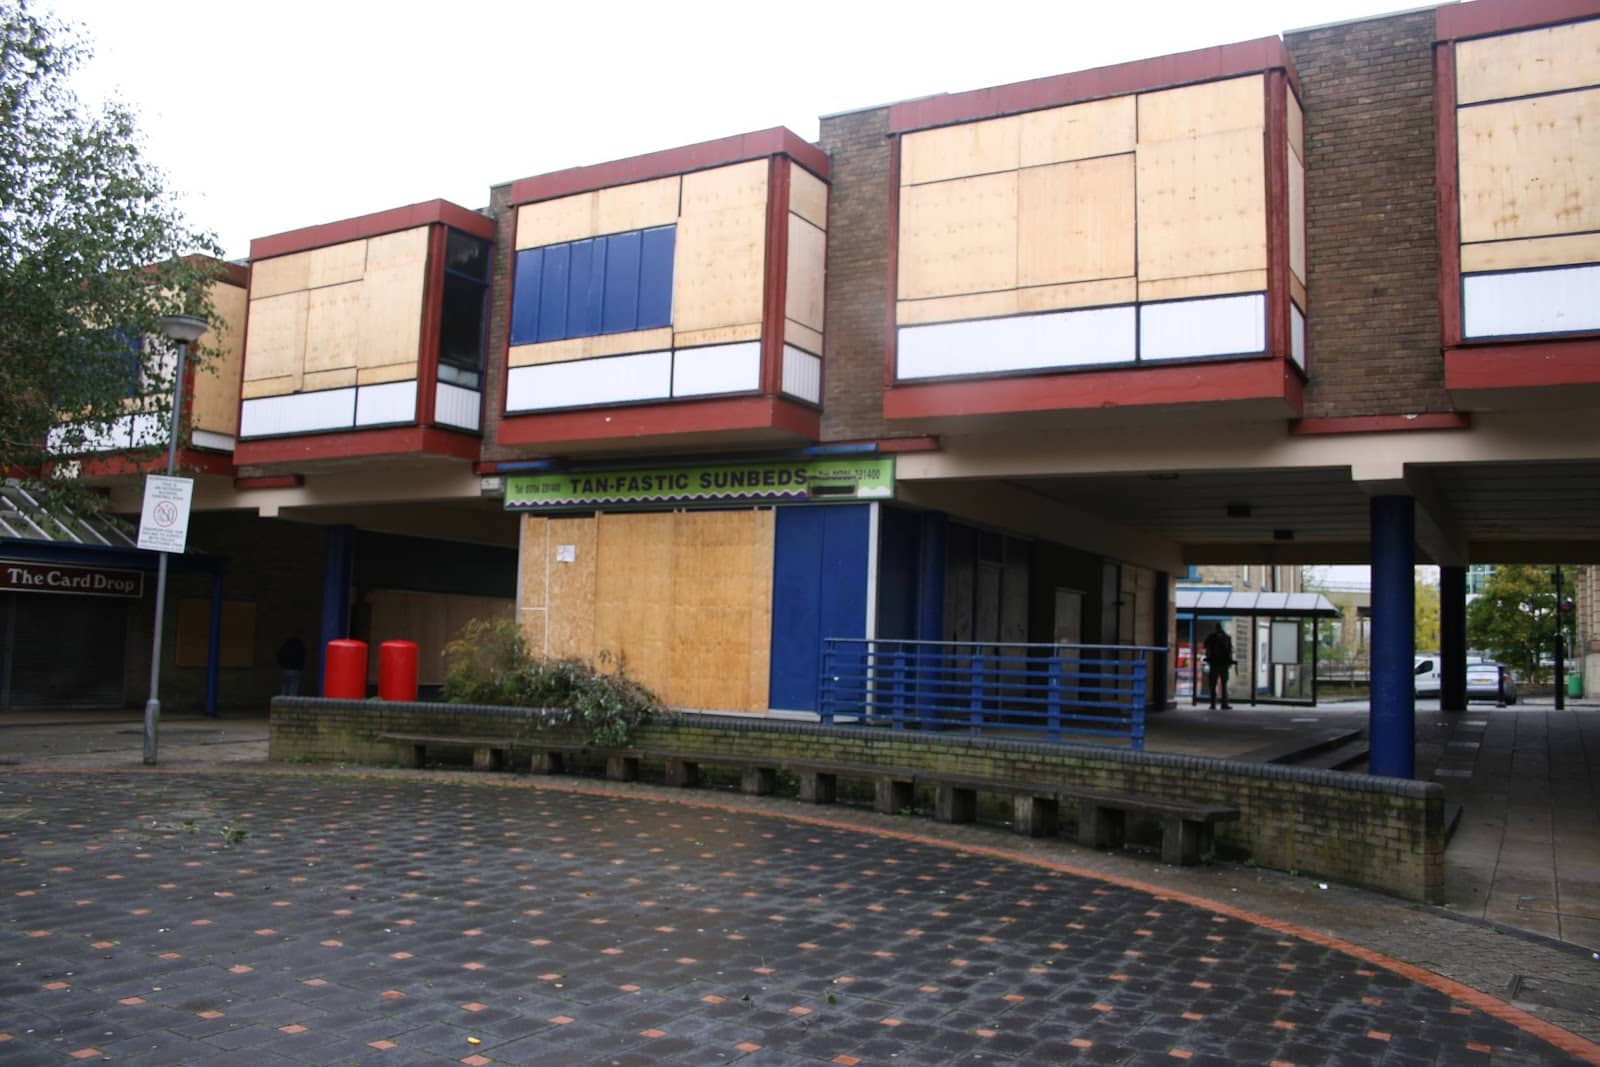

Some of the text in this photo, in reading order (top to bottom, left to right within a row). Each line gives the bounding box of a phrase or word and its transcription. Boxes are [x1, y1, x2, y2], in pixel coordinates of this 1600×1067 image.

[570, 473, 689, 494] TAN-FASTIC
[699, 468, 808, 489] SUNBEDS
[7, 567, 135, 593] The Card Drop
